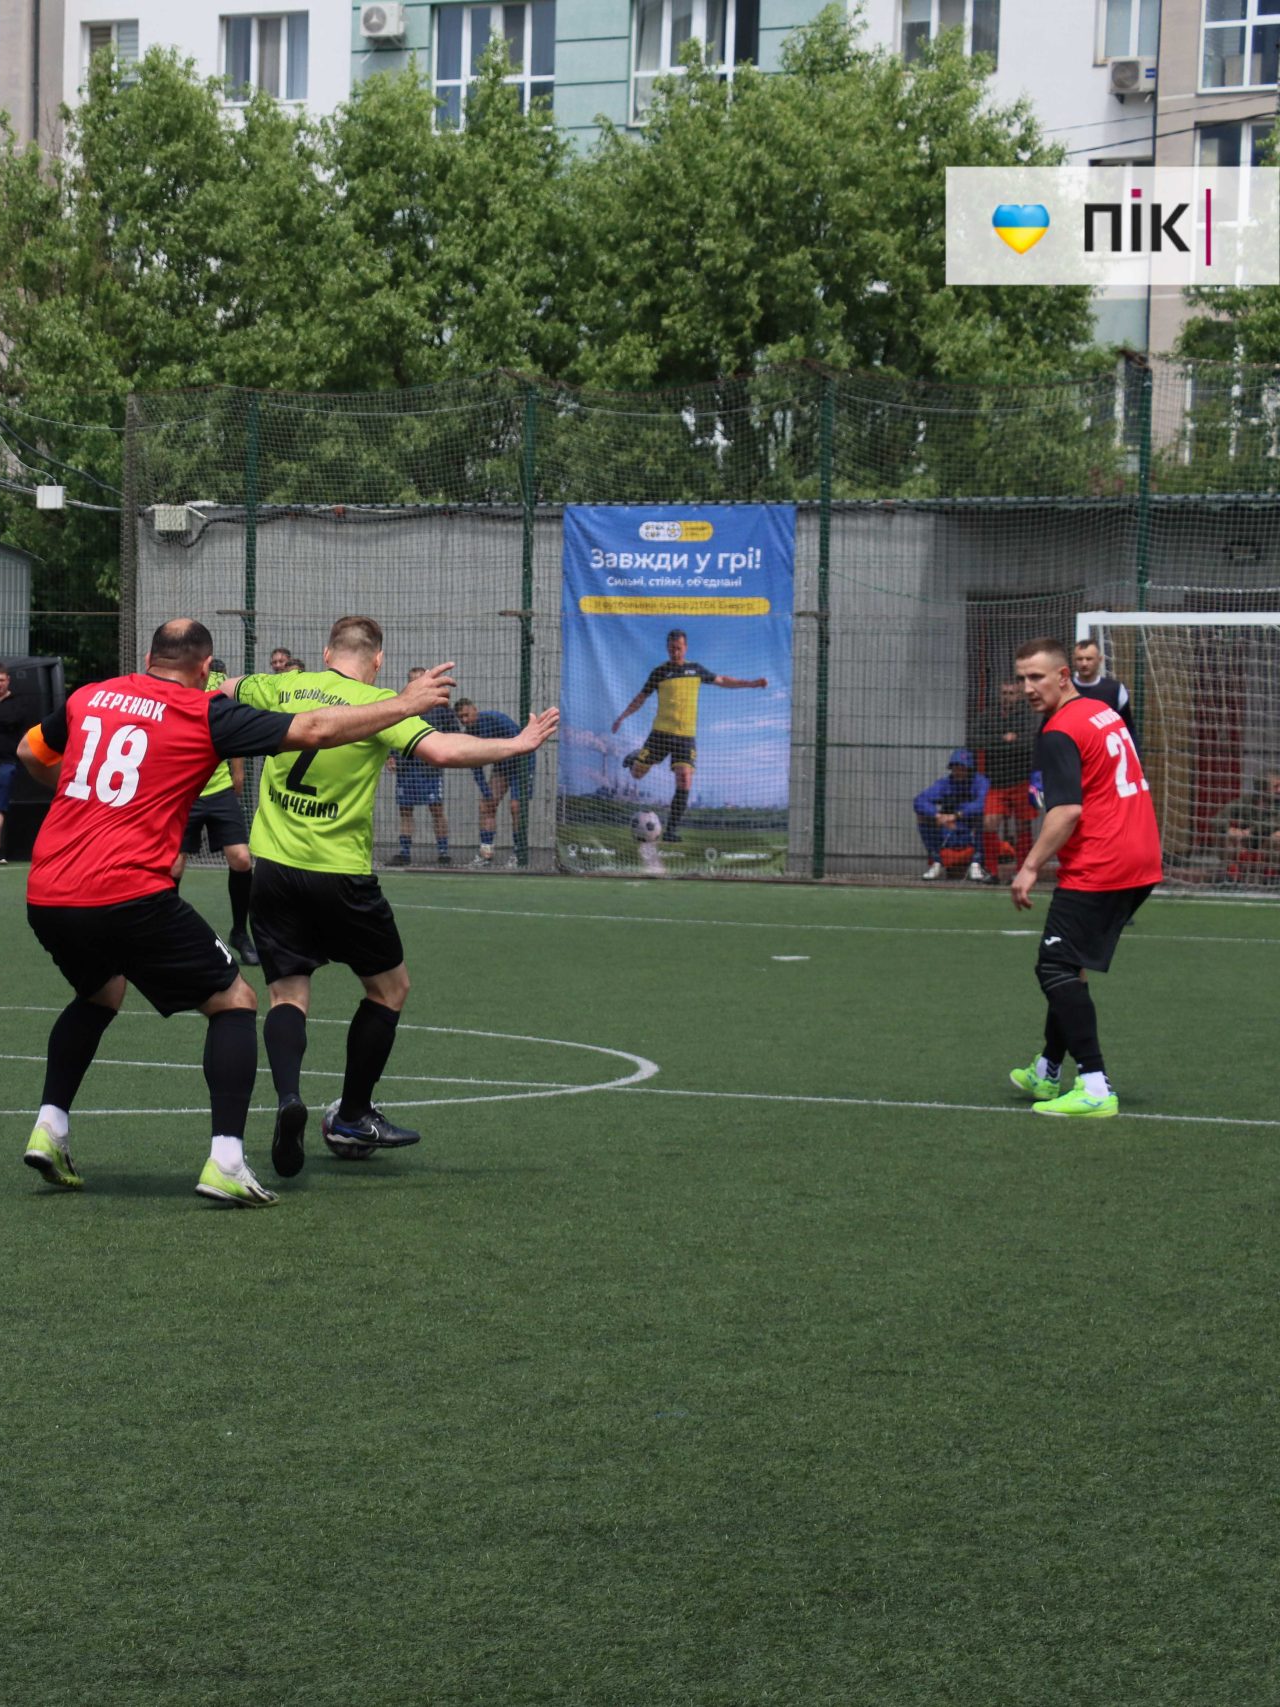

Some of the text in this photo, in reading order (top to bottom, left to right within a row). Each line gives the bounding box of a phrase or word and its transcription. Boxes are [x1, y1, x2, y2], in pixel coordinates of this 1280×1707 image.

[589, 546, 762, 574] Завжди у грі!
[87, 688, 168, 723] ДЕРЕНЮК
[65, 715, 148, 807] 18
[215, 933, 233, 965] 1
